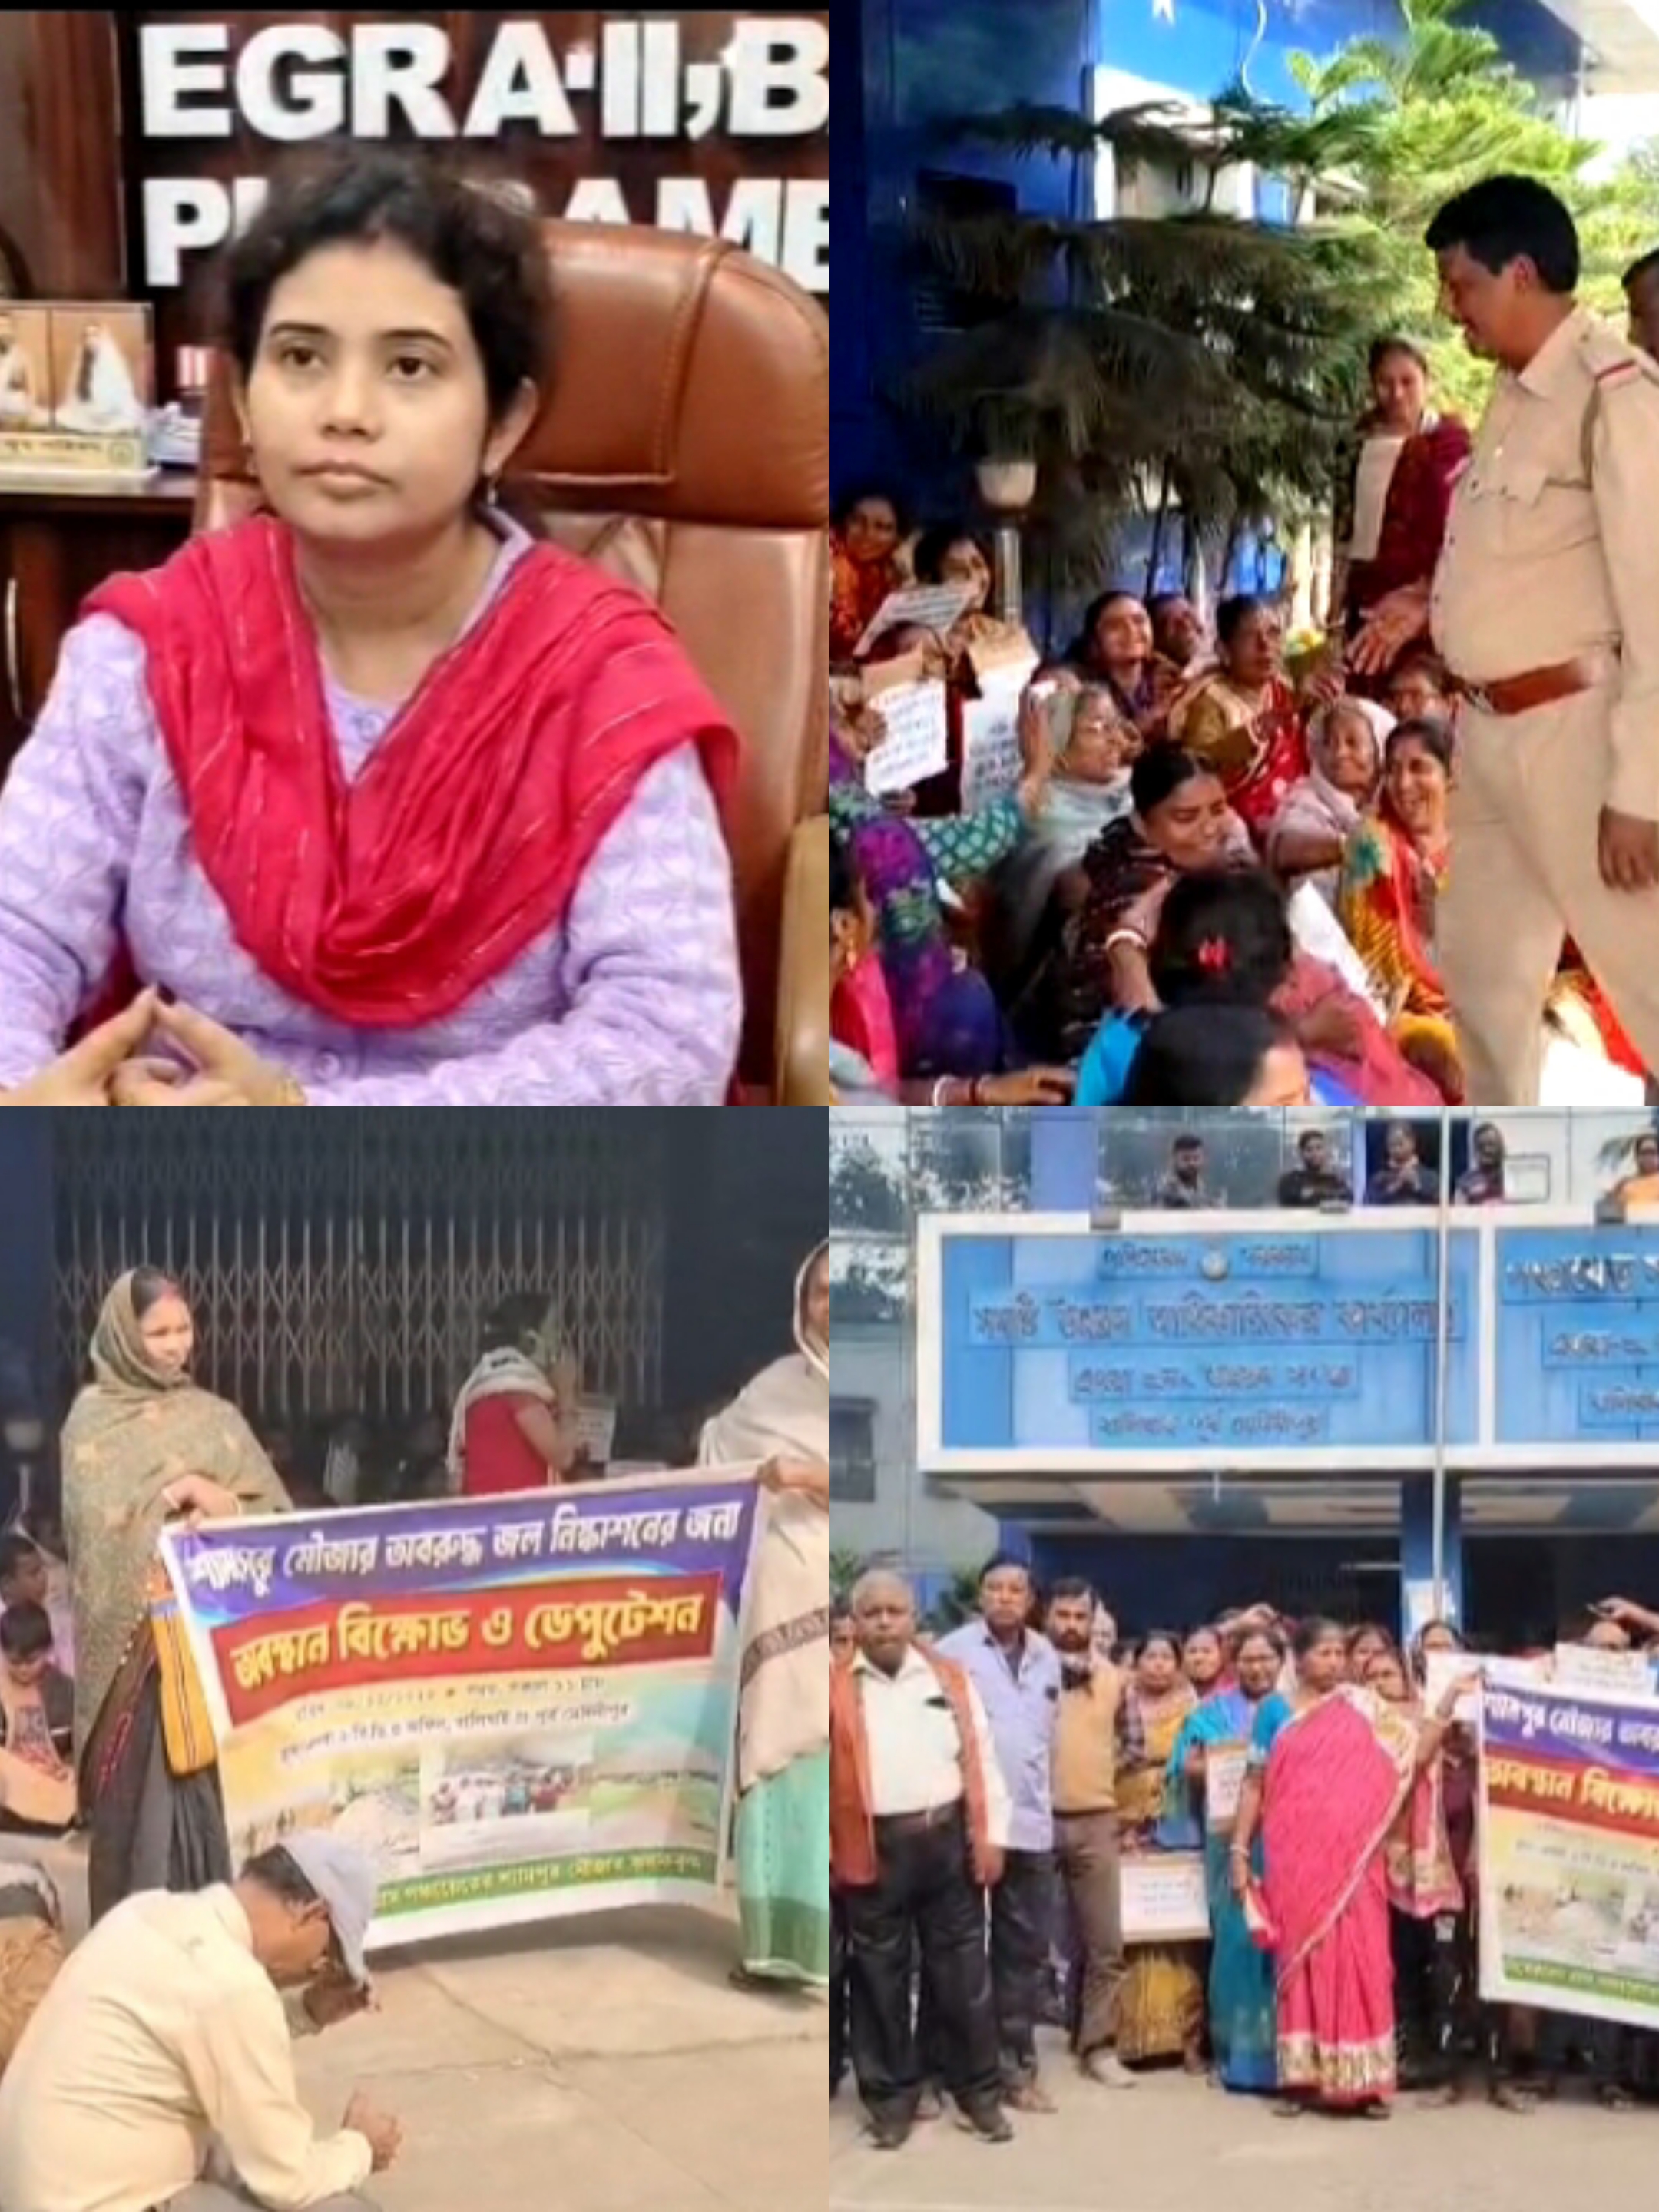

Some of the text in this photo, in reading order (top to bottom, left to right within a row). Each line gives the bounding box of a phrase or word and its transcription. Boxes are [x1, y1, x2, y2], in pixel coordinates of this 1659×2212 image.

[492, 1521, 545, 1558] জল
[336, 1601, 472, 1661] বিক্ষোভ
[481, 1605, 514, 1646] ও
[524, 1587, 704, 1661] ডেপুটেশন
